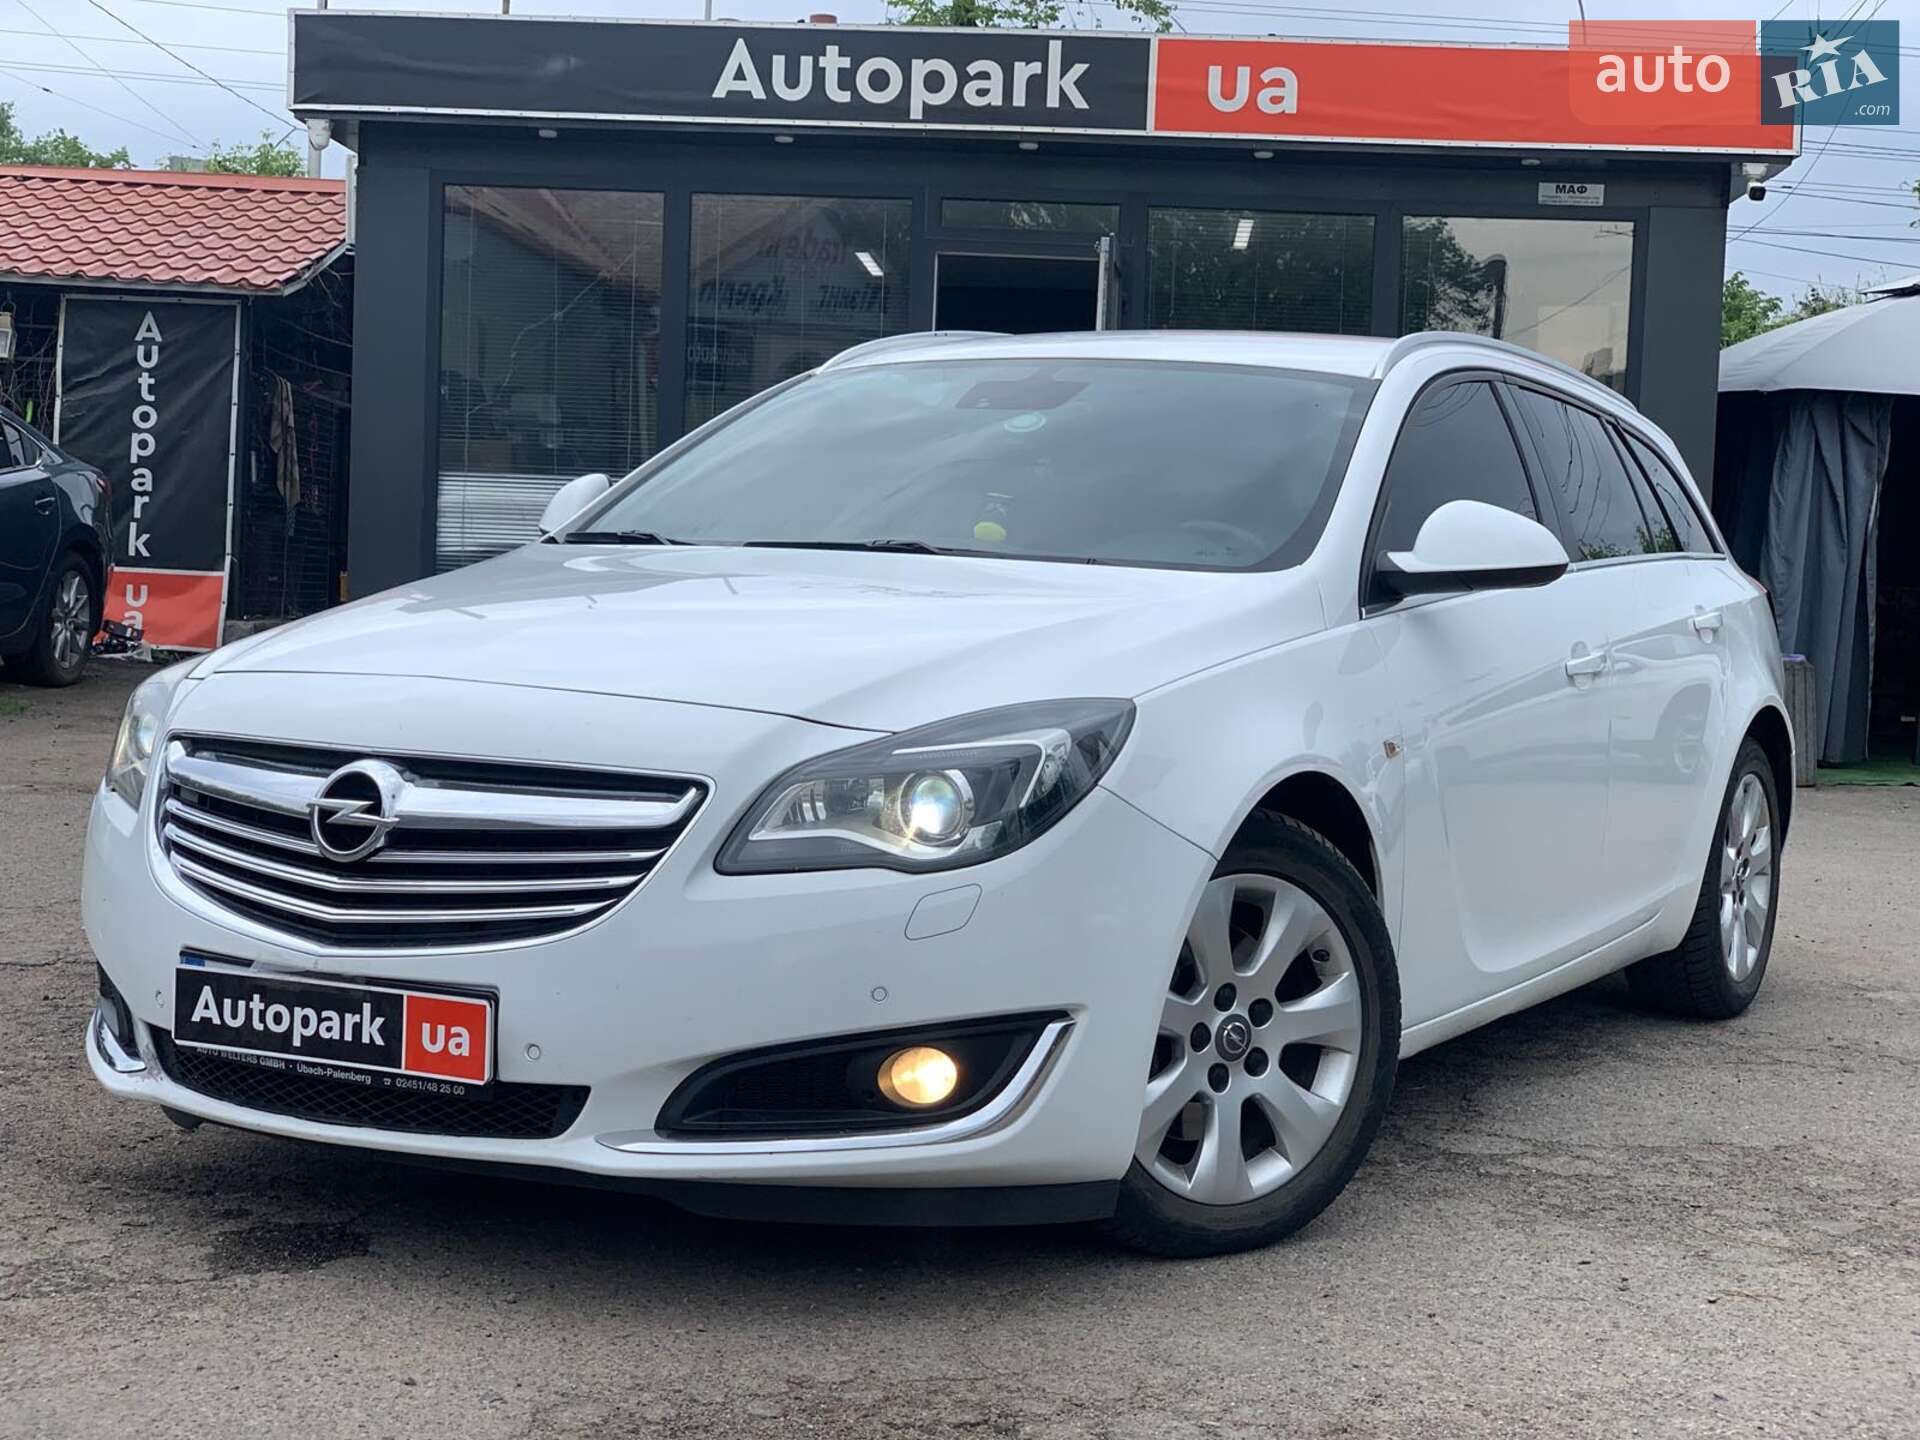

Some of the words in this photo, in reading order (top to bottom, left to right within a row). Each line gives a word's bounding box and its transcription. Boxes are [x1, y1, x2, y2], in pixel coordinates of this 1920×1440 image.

[712, 38, 1090, 120] Autopark
[1207, 65, 1298, 114] ua
[1555, 184, 1588, 195] МАФ
[128, 310, 162, 557] Autopark
[191, 985, 386, 1047] Autopark
[421, 1021, 470, 1057] ua
